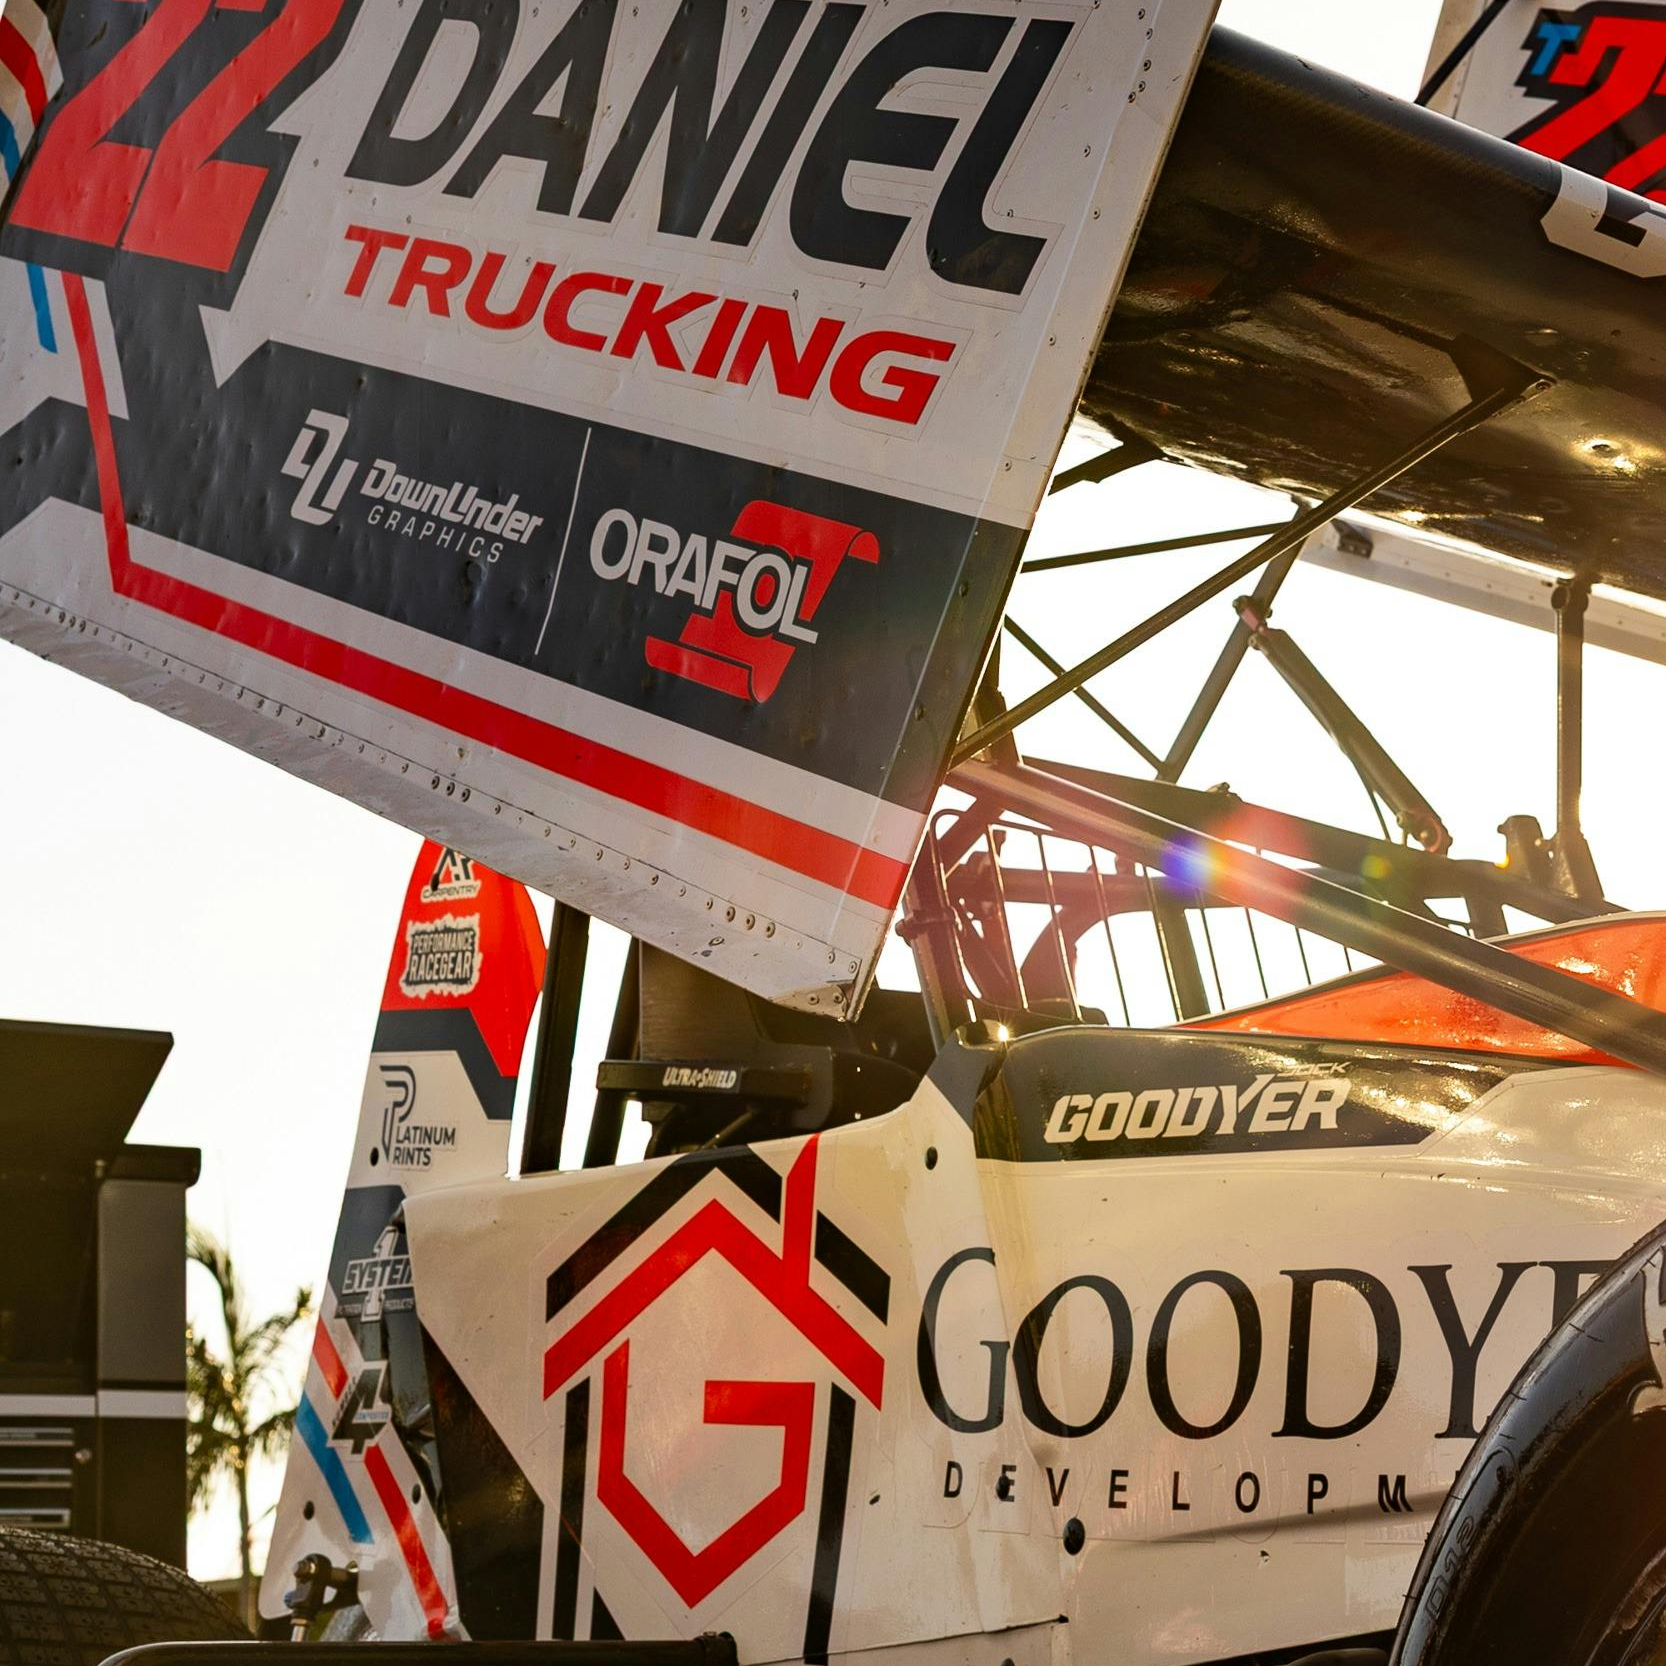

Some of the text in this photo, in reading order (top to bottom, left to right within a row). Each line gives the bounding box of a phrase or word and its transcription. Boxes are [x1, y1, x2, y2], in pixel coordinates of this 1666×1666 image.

[343, 225, 957, 425] TRUCKING
[360, 458, 544, 544] DownUnder
[367, 505, 504, 564] GRAPHICS
[590, 508, 819, 645] ORAFOL
[408, 951, 473, 982] RACEGEAR
[412, 930, 474, 953] PERFORMANCE
[1043, 1073, 1353, 1143] GOODYER
[943, 1460, 1462, 1514] DEVELOPM
